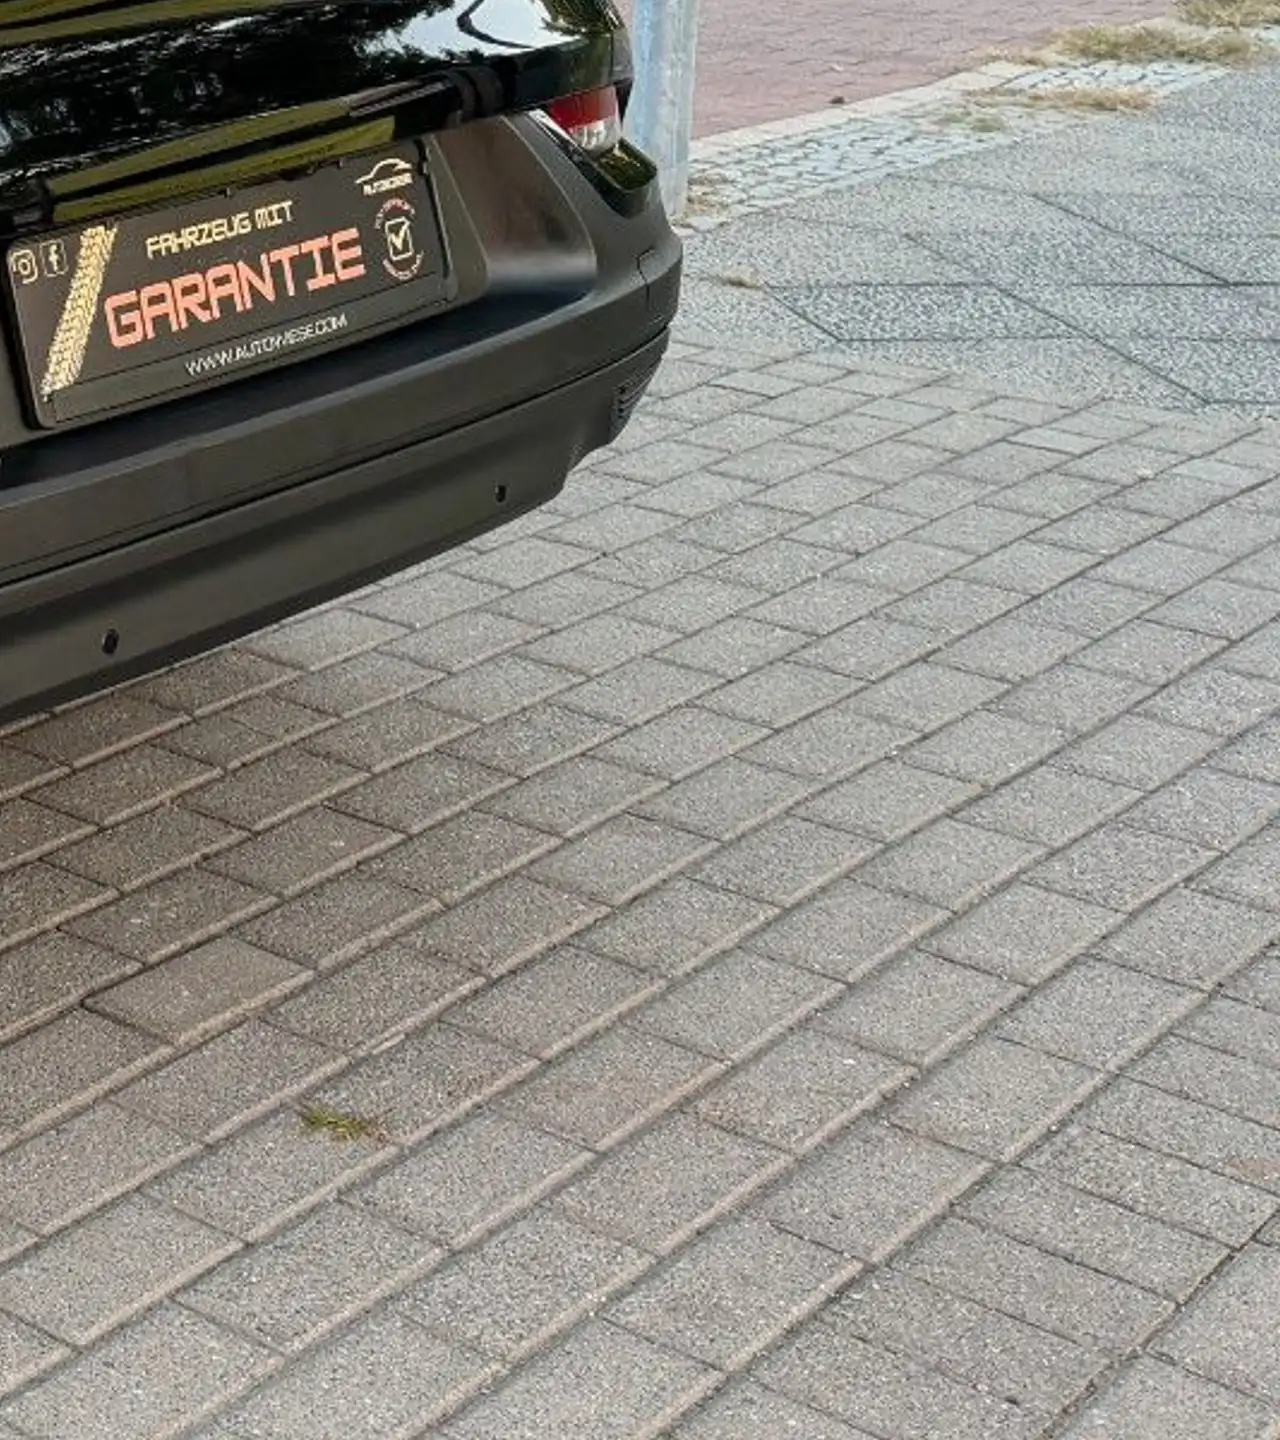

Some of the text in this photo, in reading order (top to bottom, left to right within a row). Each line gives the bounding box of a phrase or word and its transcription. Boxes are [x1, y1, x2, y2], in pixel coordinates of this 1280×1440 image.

[145, 200, 293, 259] FAHRZEUG MIT
[104, 227, 367, 349] GARANTIE
